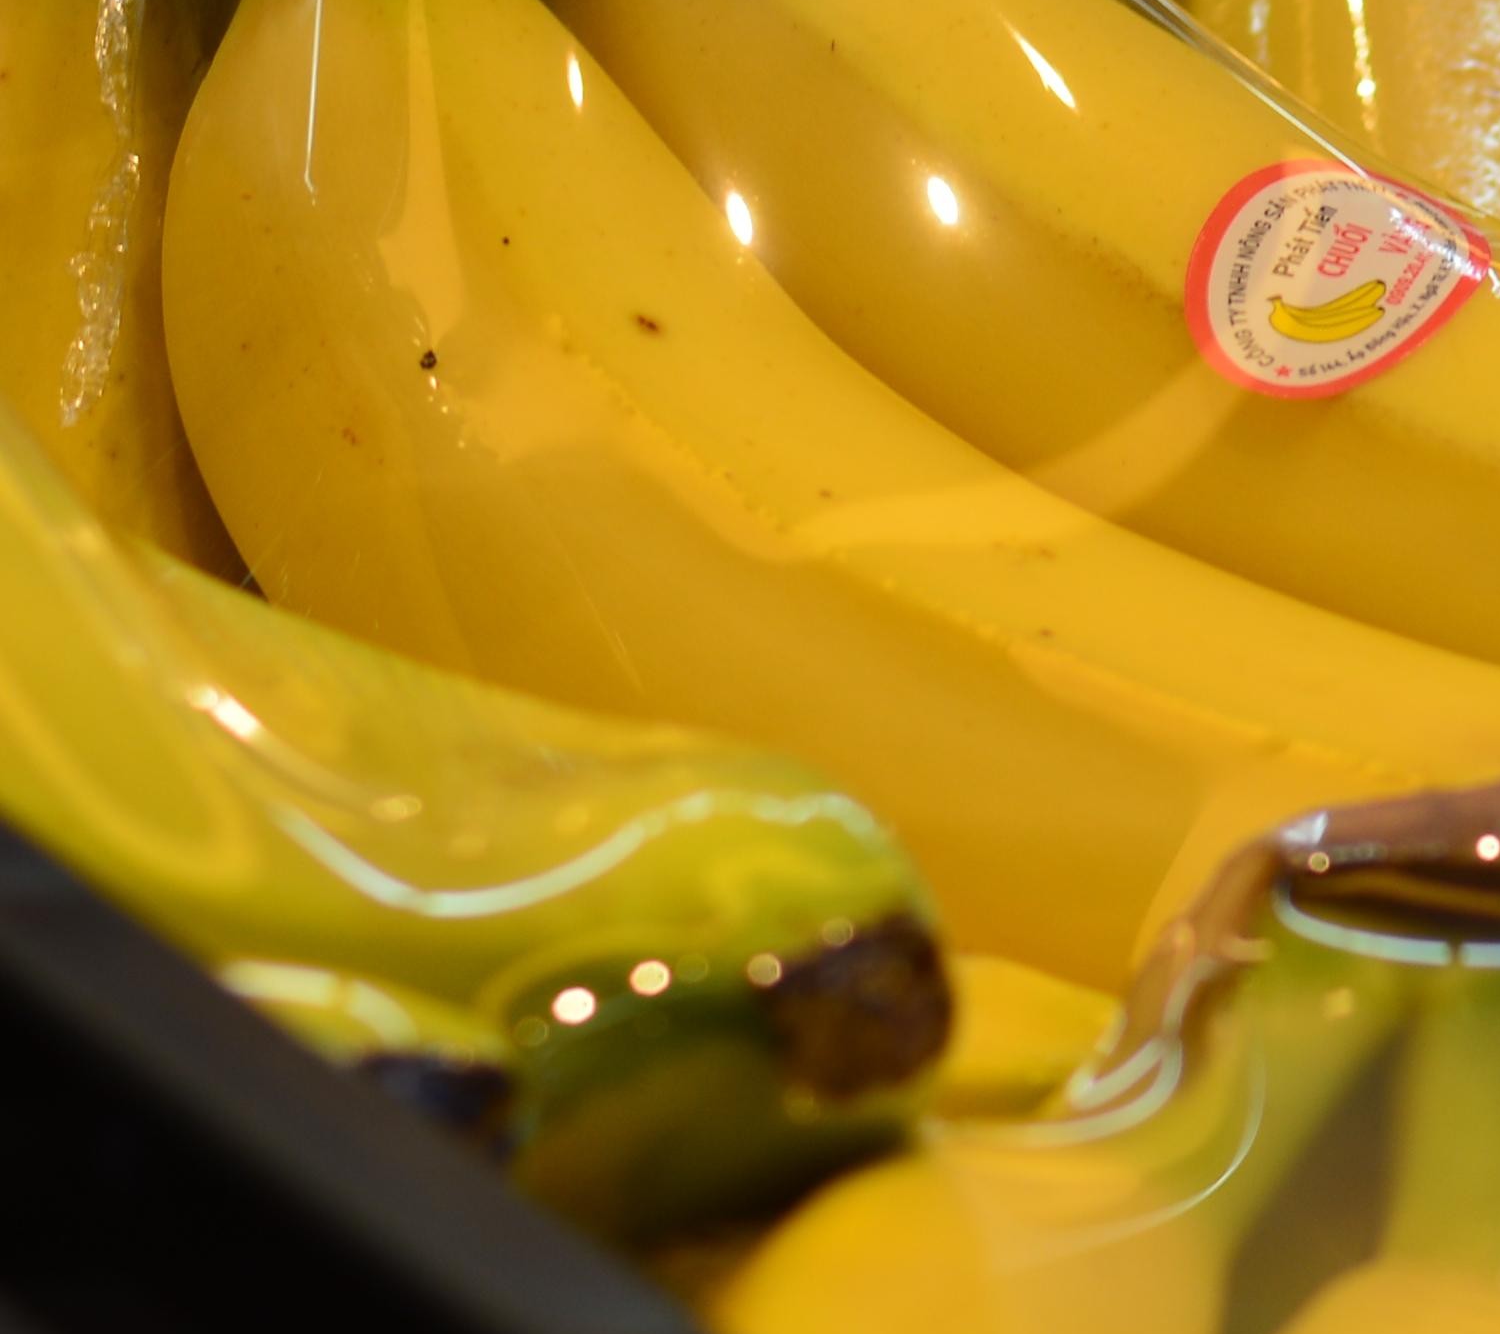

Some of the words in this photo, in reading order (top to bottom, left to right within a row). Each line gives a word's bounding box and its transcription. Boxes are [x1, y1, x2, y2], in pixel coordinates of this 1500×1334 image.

[1235, 218, 1272, 262] NÔNG
[1273, 234, 1315, 278] Phát
[1298, 204, 1338, 242] Tiến
[1317, 222, 1374, 278] CHUỐI
[1227, 263, 1249, 308] TNHH
[1228, 308, 1248, 327] TY
[1234, 325, 1276, 368] CÔNG
